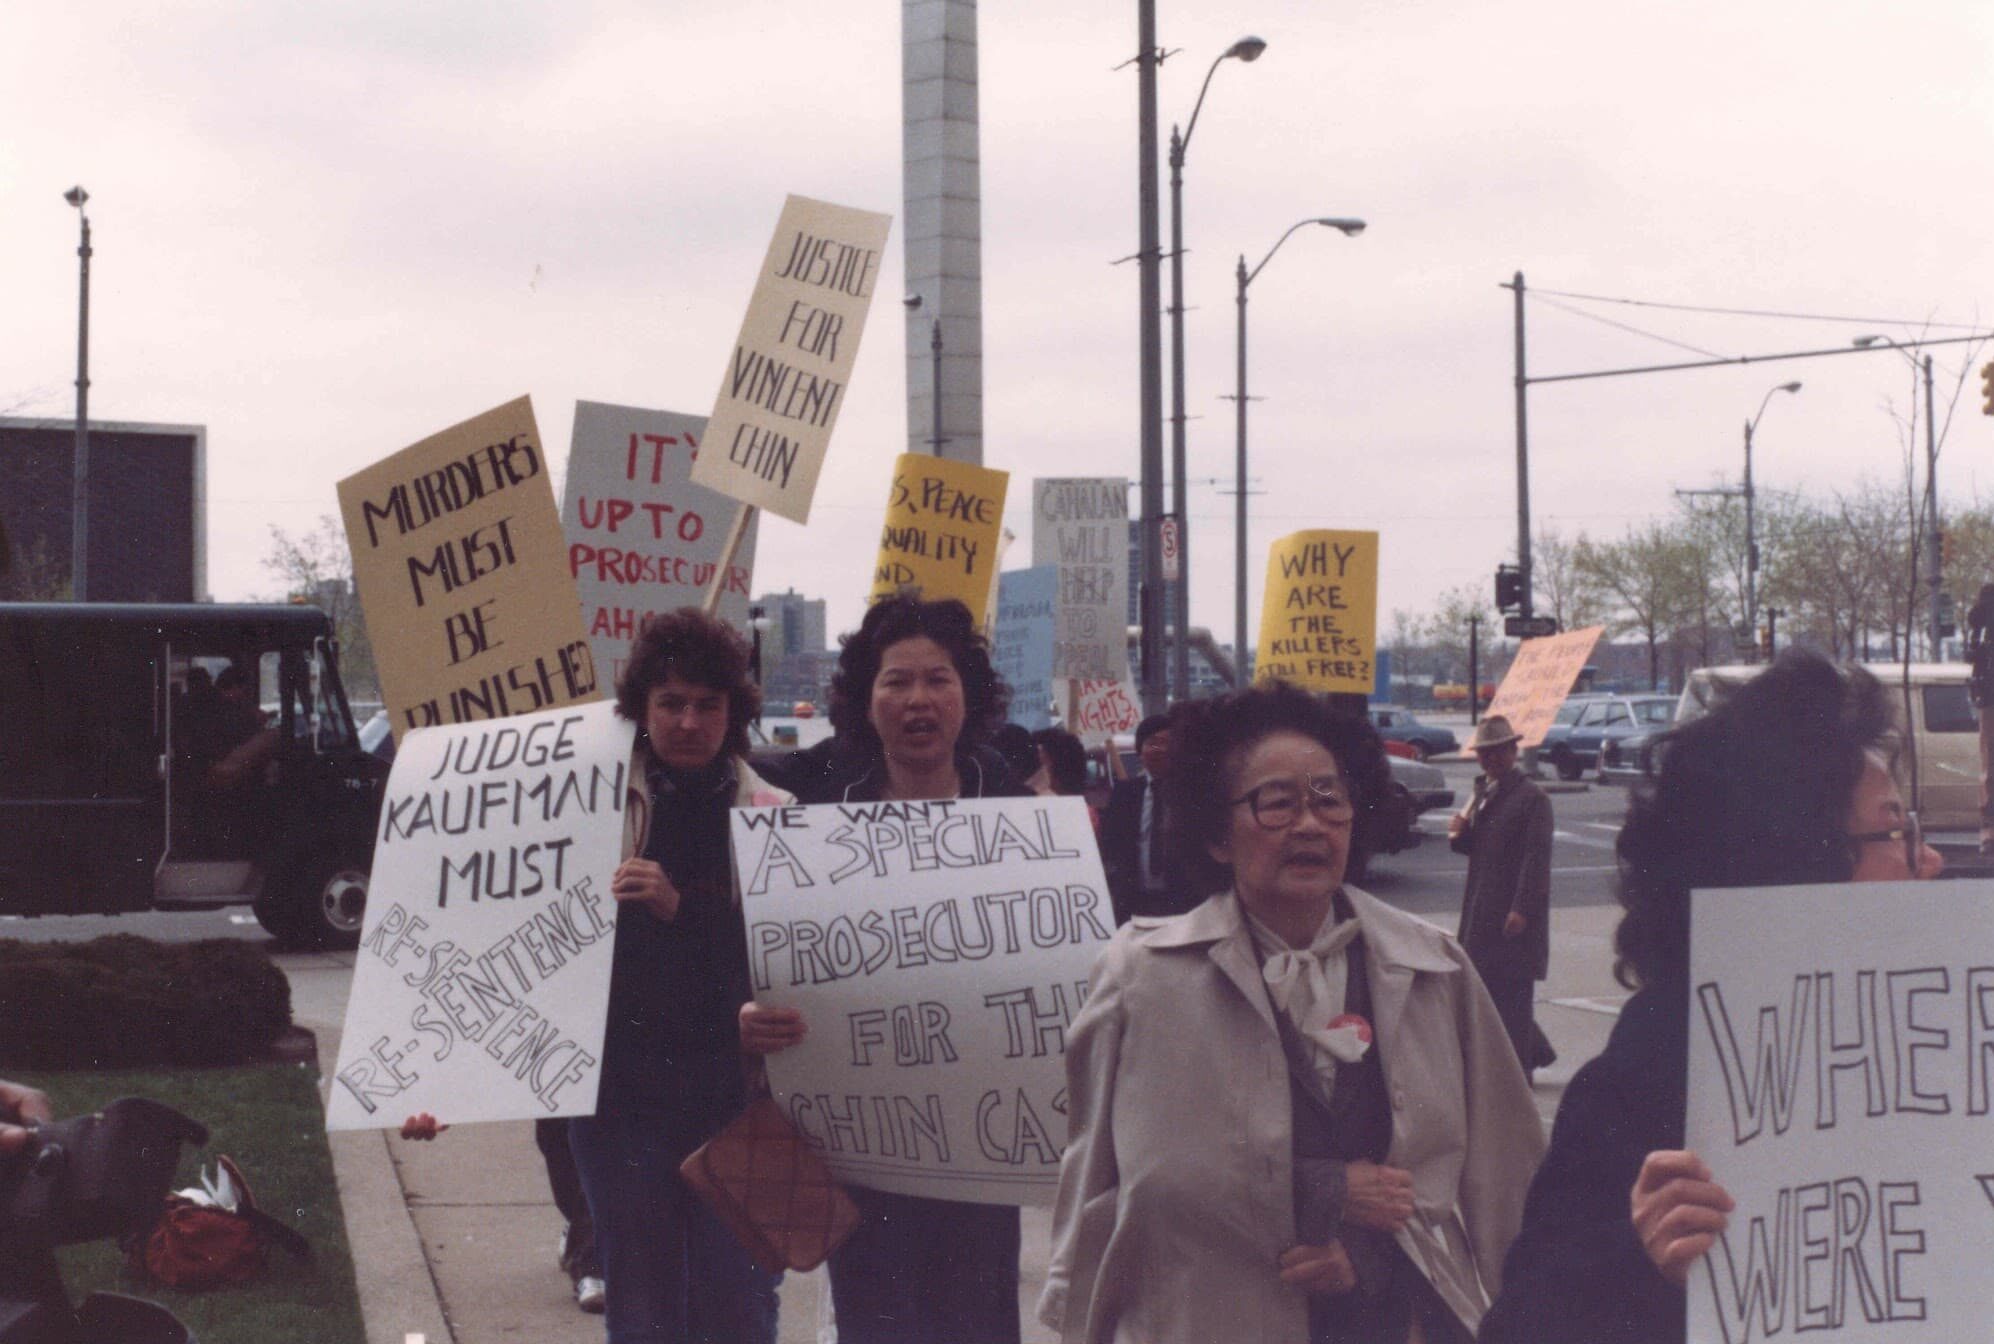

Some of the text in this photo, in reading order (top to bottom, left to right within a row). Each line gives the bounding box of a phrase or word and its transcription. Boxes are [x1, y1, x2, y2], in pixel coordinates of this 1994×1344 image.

[774, 231, 878, 298] JUSTICE
[780, 300, 844, 363] FOR
[731, 346, 844, 428] VINCENT
[627, 432, 698, 484] IT'
[729, 422, 800, 489] CHIN
[362, 434, 539, 548] MURDERS
[579, 496, 705, 542] UP TO
[889, 475, 995, 524] S, PEACE
[407, 516, 516, 607] MUST
[569, 543, 750, 596] PROSECUTR
[876, 562, 915, 584] ND
[1057, 526, 1112, 563] WILL
[1280, 541, 1355, 579] WHY
[1062, 606, 1098, 640] TO
[1286, 584, 1348, 610] ARE
[1288, 615, 1343, 634] THE
[446, 598, 505, 667] BE
[1052, 641, 1116, 679] PPEAL
[1271, 636, 1362, 656] KILLERS
[1306, 659, 1369, 681] FREE?
[430, 716, 584, 780] JUDGE
[383, 762, 625, 843] KAUFMAN
[739, 800, 957, 831] WE WANT
[438, 837, 574, 907] MUST
[747, 808, 1081, 895] A SPECIAL
[750, 885, 1112, 991] PROSECUTOR
[337, 876, 615, 1113] RE-SENTENCE
[848, 1001, 958, 1066] FOR
[789, 1087, 1069, 1165] CHIN CA
[1703, 1176, 1927, 1343] WERE
